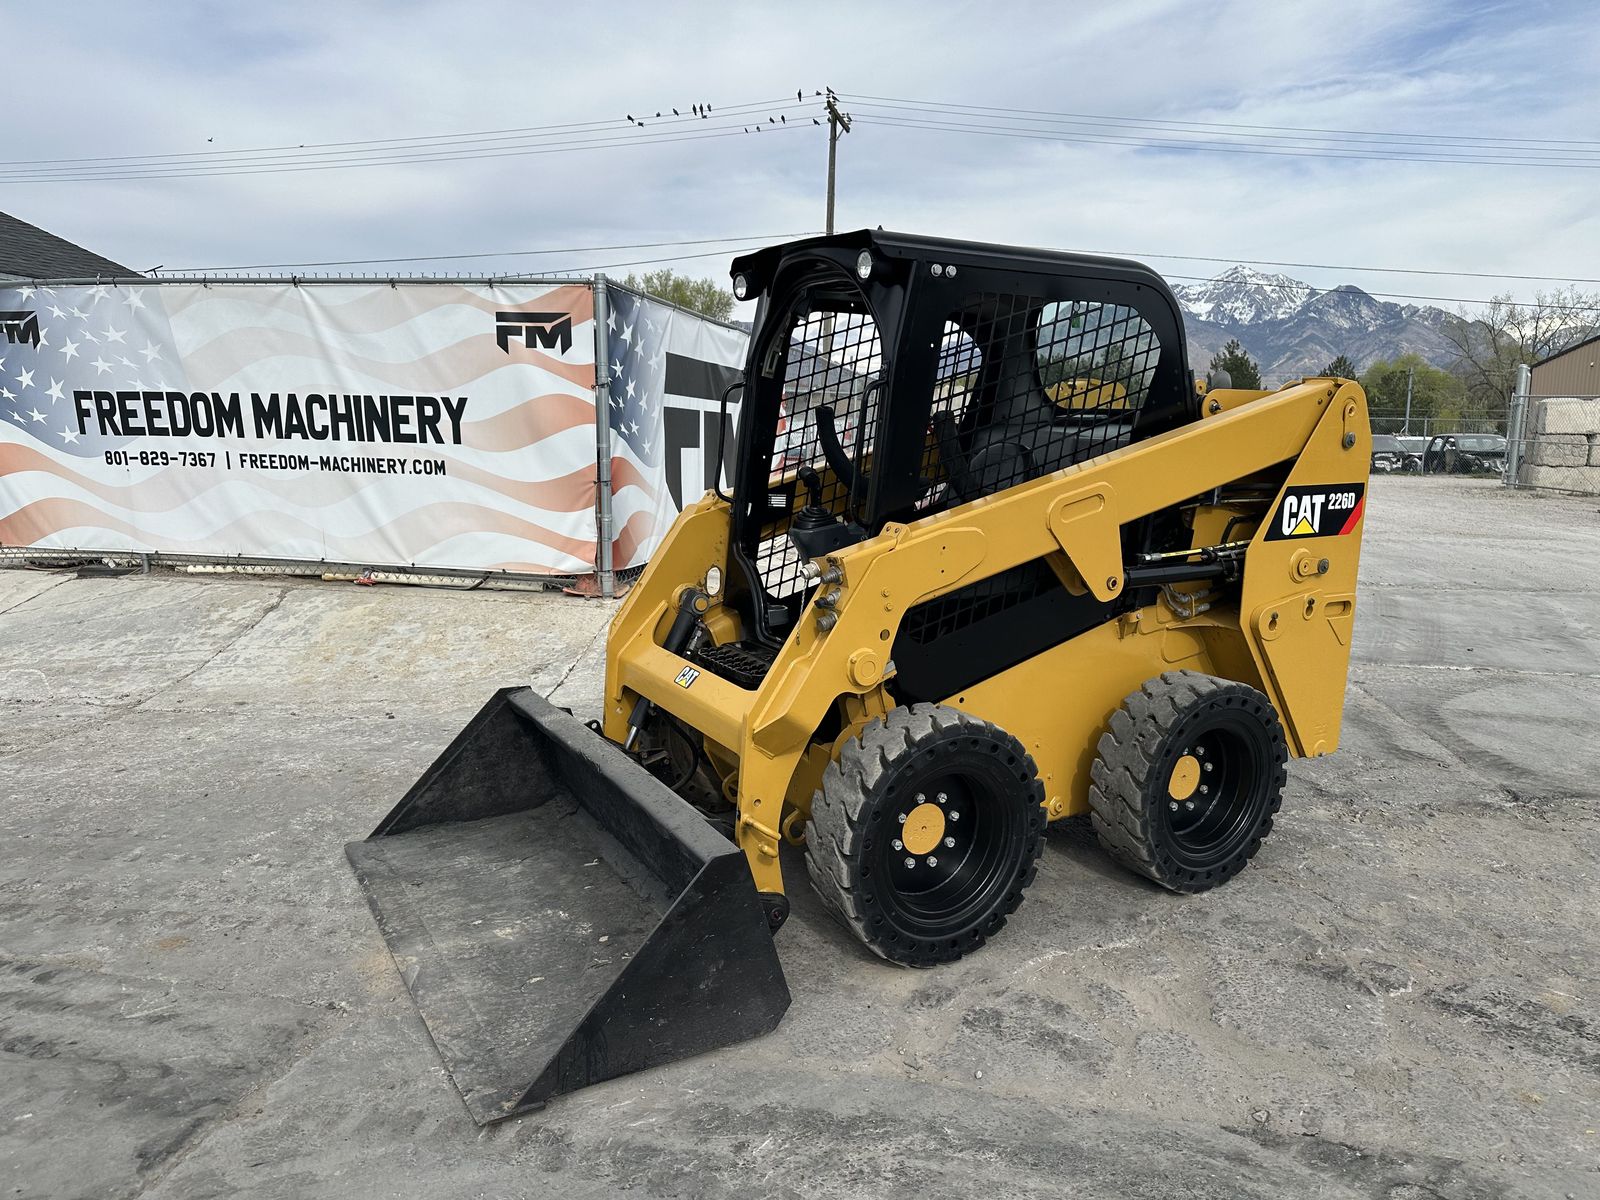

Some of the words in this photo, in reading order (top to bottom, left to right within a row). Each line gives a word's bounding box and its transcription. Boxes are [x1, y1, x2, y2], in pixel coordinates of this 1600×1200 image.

[495, 311, 573, 356] FM
[73, 391, 245, 438] FREEDOM
[250, 393, 468, 445] MACHINERY
[104, 450, 216, 468] 801-829-7367
[239, 453, 446, 476] FREEDOM-MACHINERY.COM
[1281, 494, 1326, 536] CAT
[1327, 492, 1356, 510] 226D
[675, 666, 700, 688] CAT
